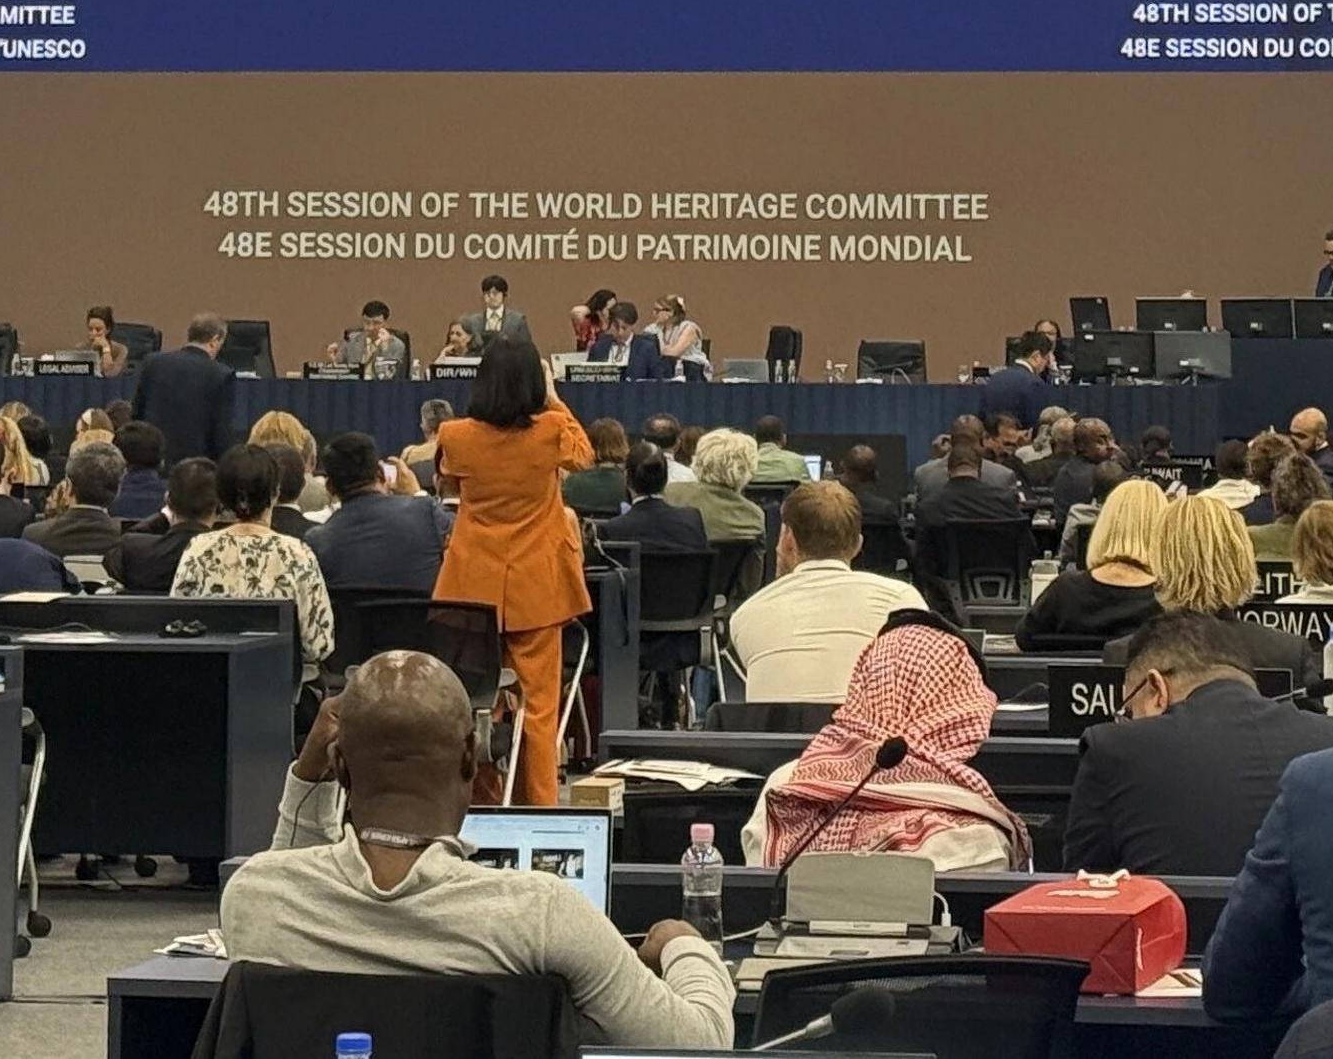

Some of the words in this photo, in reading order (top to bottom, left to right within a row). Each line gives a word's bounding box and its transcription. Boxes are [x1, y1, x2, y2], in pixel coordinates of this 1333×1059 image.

[1133, 3, 1190, 23] 48TH
[1194, 3, 1287, 23] SESSION
[1293, 3, 1324, 23] OF
[1120, 38, 1160, 58] 48E
[1165, 38, 1258, 58] SESSION
[1263, 38, 1294, 58] DU
[203, 191, 279, 218] 48TH
[286, 191, 412, 218] SESSION
[420, 191, 459, 218] OF
[468, 191, 529, 218] THE
[536, 192, 642, 219] WORLD
[651, 192, 797, 219] HERITAGE
[805, 193, 989, 220] COMMITTEE
[218, 232, 272, 259] 48E
[279, 232, 406, 259] SESSION
[415, 232, 456, 259] DU
[463, 228, 579, 260] COMITÉ
[587, 234, 628, 261] DU
[636, 234, 821, 261] PATRIMOINE
[829, 234, 972, 261] MONDIAL
[435, 367, 478, 379] DIR/WH
[1071, 682, 1127, 716] SAU
